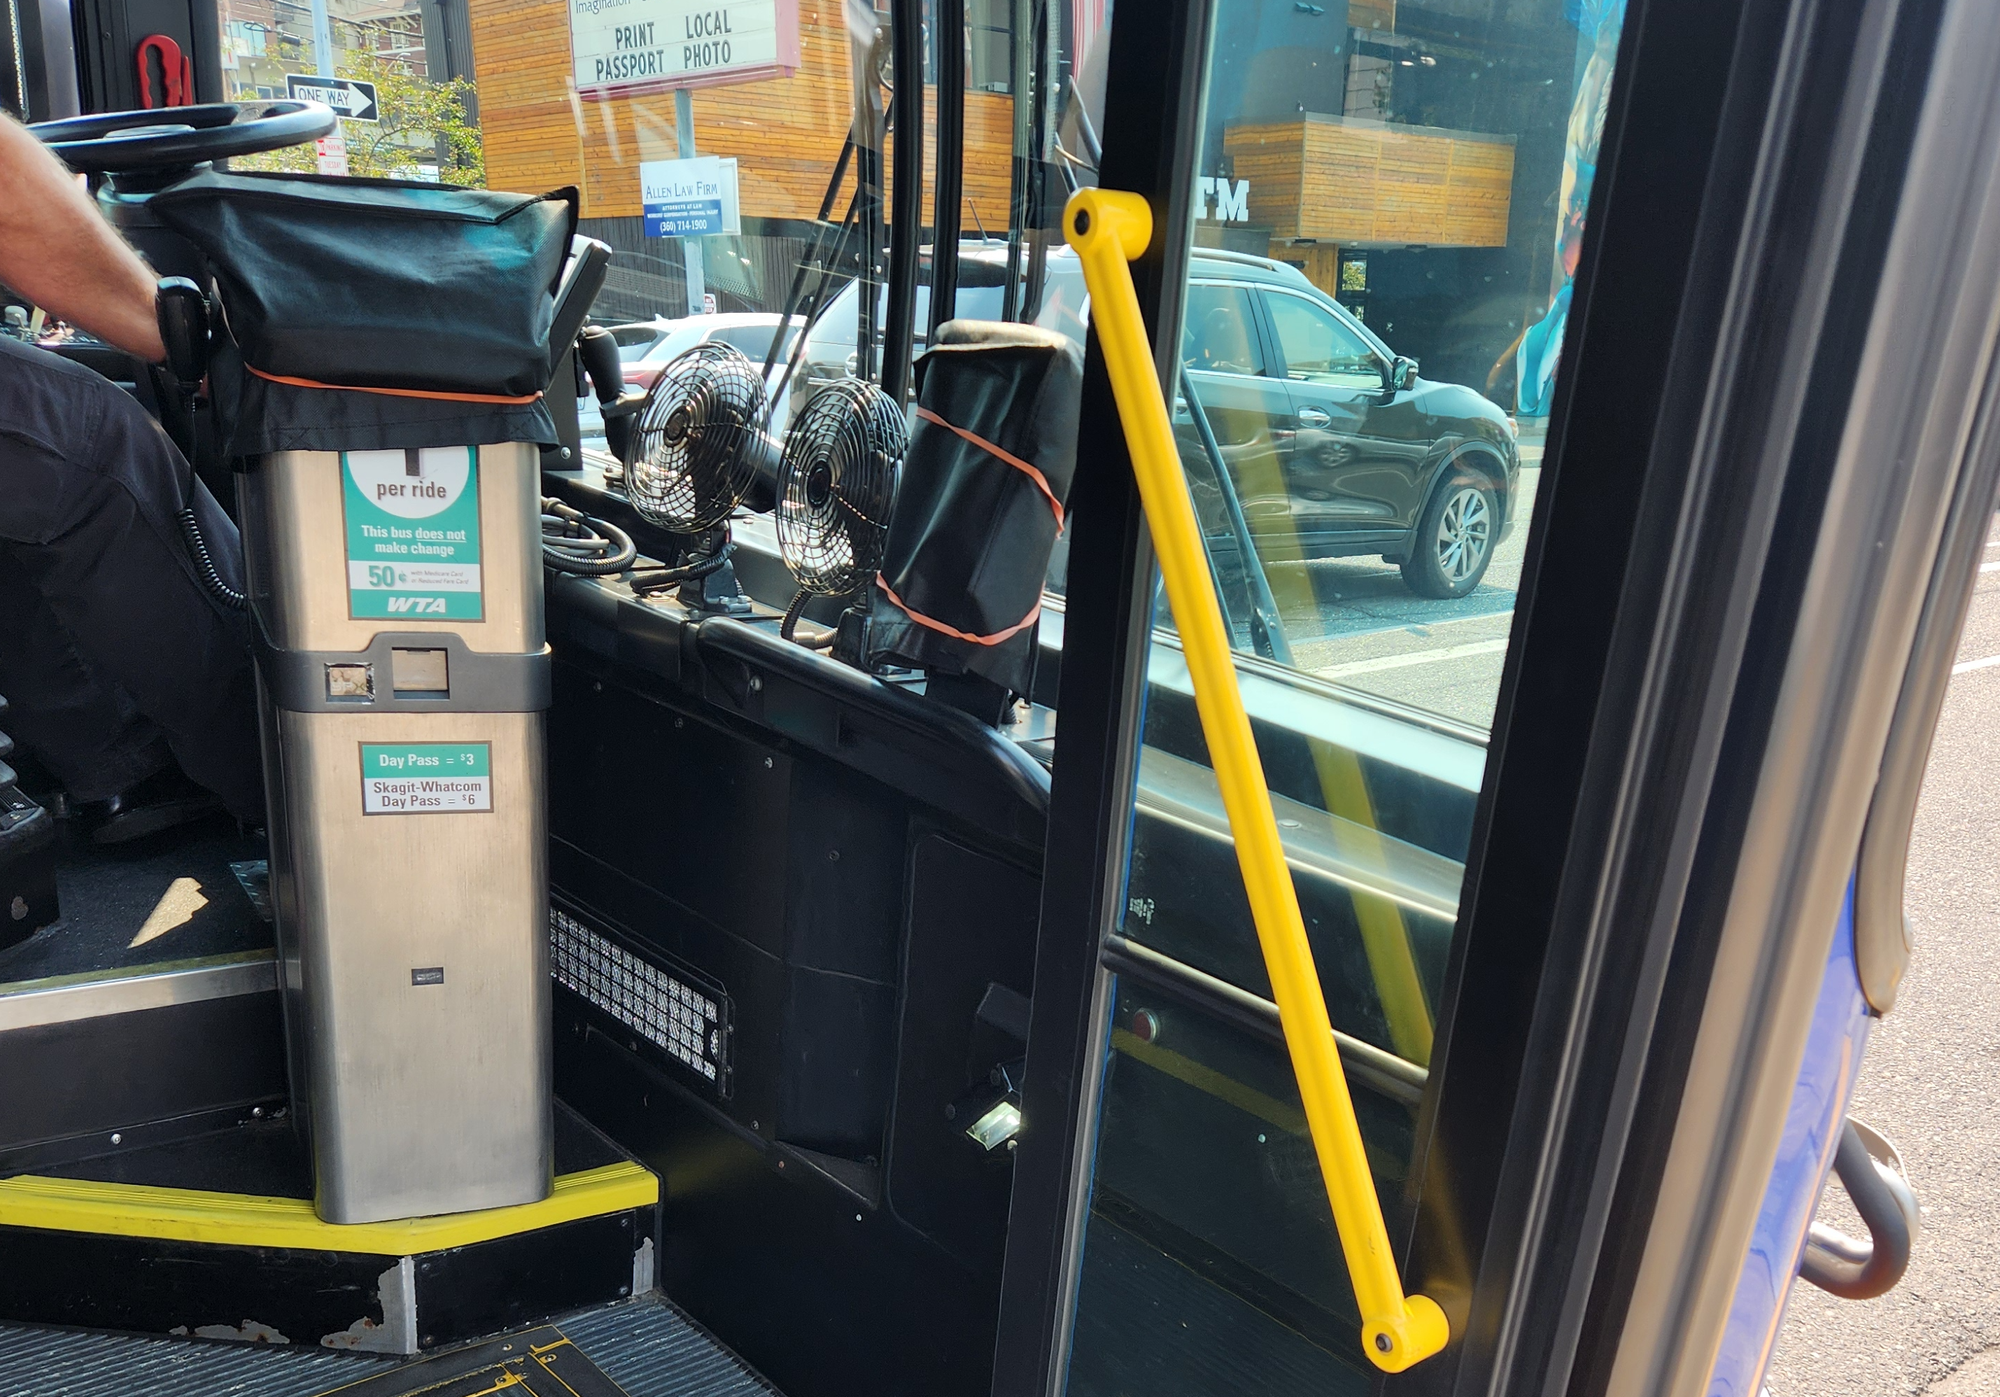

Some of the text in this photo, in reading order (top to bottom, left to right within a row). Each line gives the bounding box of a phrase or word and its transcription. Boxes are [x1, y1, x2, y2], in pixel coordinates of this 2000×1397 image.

[615, 9, 732, 50] PRINT LOCAL
[595, 39, 731, 81] PASSPORT PHOTO
[298, 87, 350, 106] ONE WAY
[645, 181, 718, 199] ALLEN LAW FIRM
[660, 219, 707, 234] (360) 714-1900
[377, 480, 447, 500] per ride
[361, 525, 466, 541] This bus does not
[375, 541, 455, 558] make change
[387, 597, 446, 613] WTA
[379, 754, 405, 769] Day
[408, 754, 440, 766] Pass
[460, 753, 475, 766] $3
[373, 781, 481, 796] Skagit-Whatcom
[382, 795, 407, 809] Day
[410, 795, 441, 807] Pass
[462, 794, 475, 805] $6
